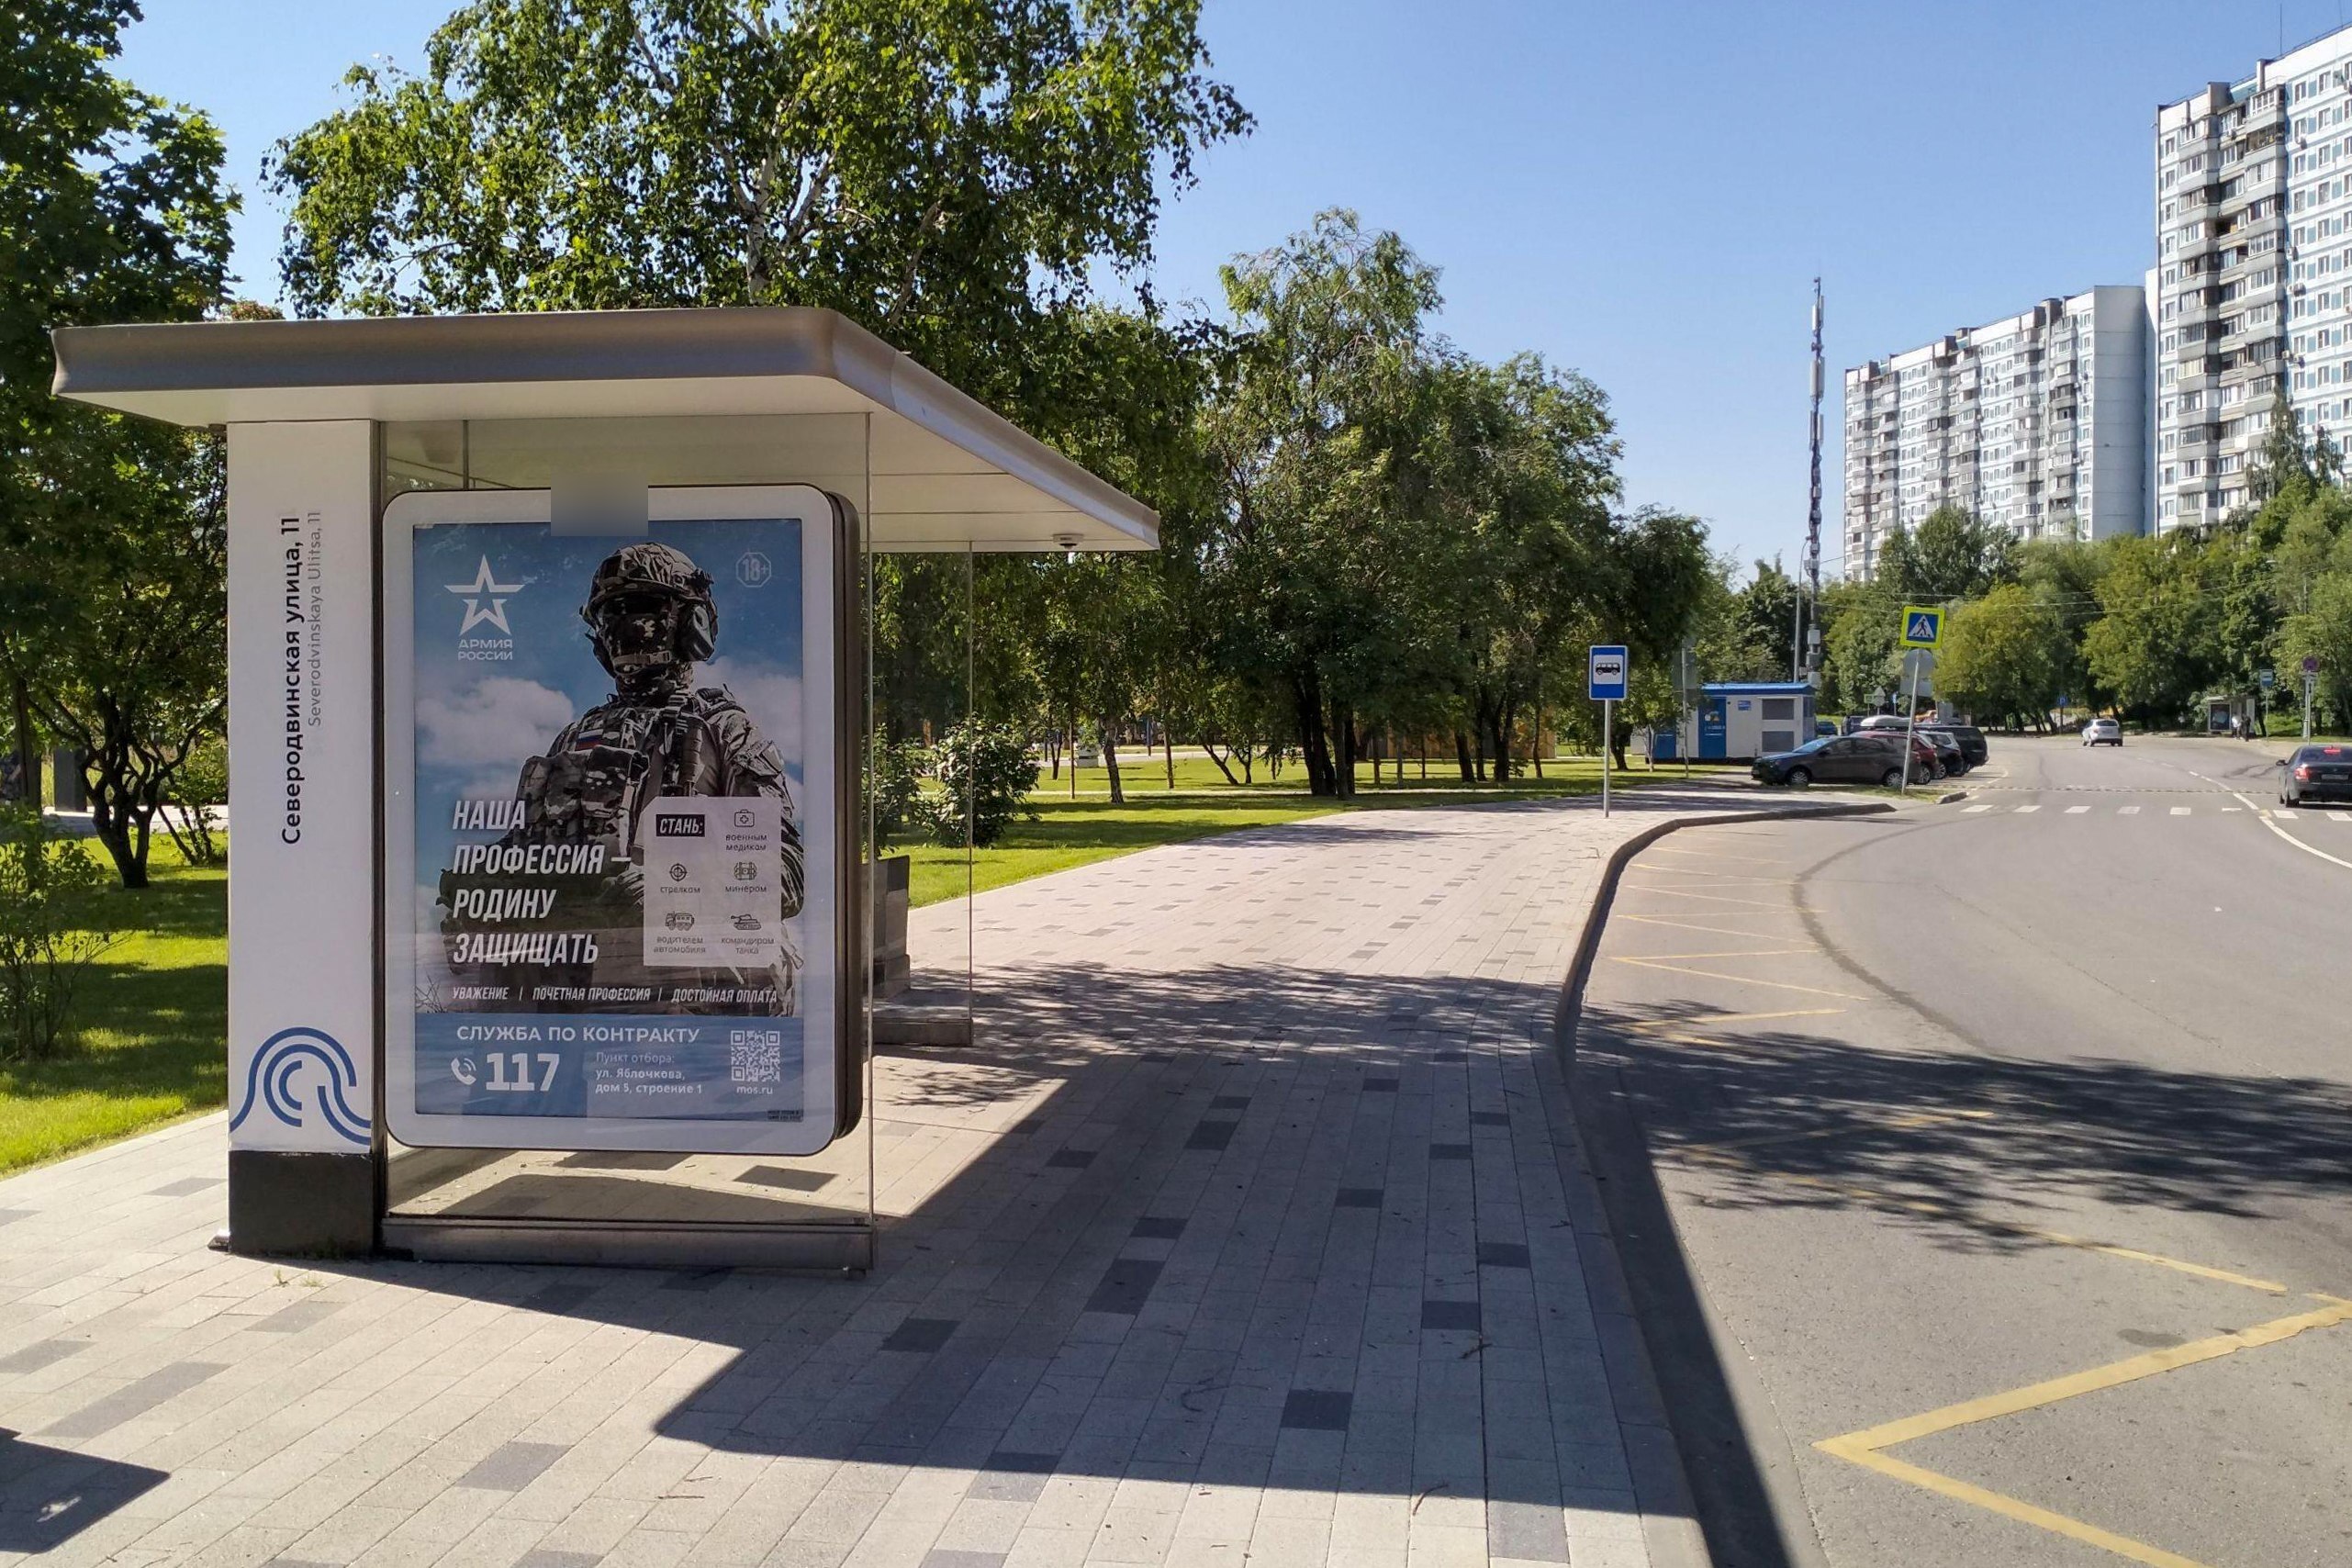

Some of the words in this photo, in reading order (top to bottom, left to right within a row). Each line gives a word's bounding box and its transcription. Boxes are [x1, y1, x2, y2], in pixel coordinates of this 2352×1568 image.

[281, 517, 300, 535] 11
[307, 511, 321, 524] 11
[307, 528, 323, 580] Ulitsa,
[742, 556, 769, 582] 18+
[283, 542, 305, 623] улица,
[458, 639, 513, 649] АРМИЯ
[307, 586, 323, 726] Severodvinskaya
[457, 650, 513, 661] РОССИИ
[281, 631, 306, 845] Северодвинская
[452, 800, 526, 831] НАША
[659, 818, 703, 834] СТАНЬ:
[725, 834, 767, 842] военным
[452, 844, 605, 875] ПРОФЕССИЯ
[659, 886, 701, 894] стрелком
[452, 888, 557, 922] РОДИНУ
[452, 933, 599, 968] ЗАЩИЩАТЬ
[452, 986, 509, 1002] УВАЖЕНИЕ
[587, 986, 651, 1002] ПРОФЕССИЯ
[671, 987, 734, 1004] ДОСТОЙНАЯ
[735, 988, 778, 1004] ОПЛАТА
[456, 1025, 541, 1042] СЛУЖБА
[548, 1026, 577, 1042] ПО
[583, 1026, 700, 1044] КОНТРАКТУ
[596, 1052, 628, 1065] Пункт
[631, 1051, 675, 1066] отбора:
[485, 1052, 560, 1092] 117
[596, 1069, 612, 1081] ул.
[616, 1068, 686, 1081] Яблочкова,
[595, 1084, 620, 1094] дом
[623, 1083, 633, 1095] 5,
[635, 1084, 694, 1096] строение
[735, 1085, 774, 1096] mos.ru
